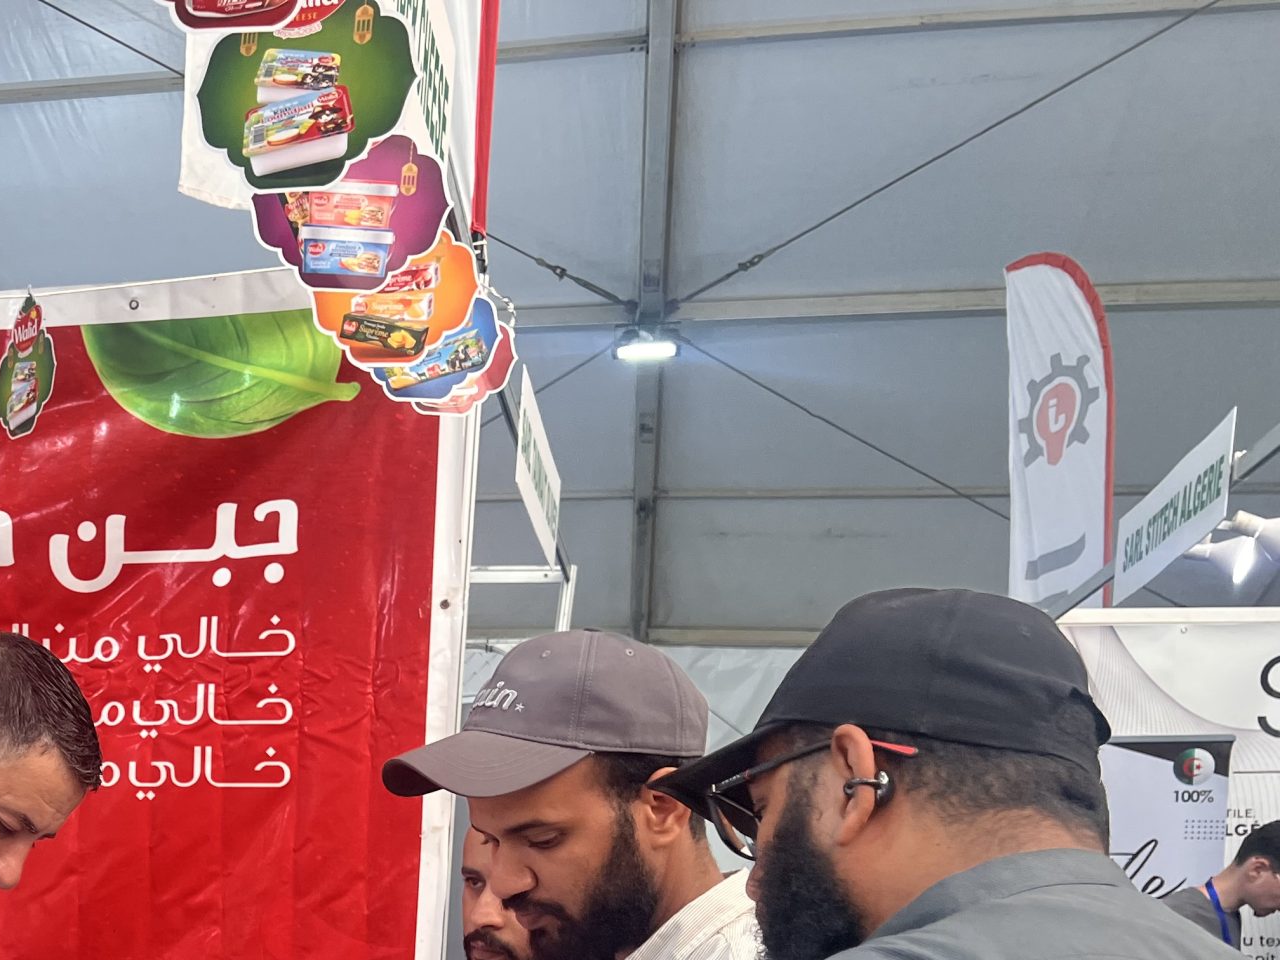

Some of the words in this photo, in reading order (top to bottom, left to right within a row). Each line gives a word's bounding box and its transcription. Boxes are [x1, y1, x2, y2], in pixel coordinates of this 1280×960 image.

[388, 274, 412, 285] prême
[13, 318, 39, 345] Walid
[1180, 455, 1226, 526] ALGERIE
[47, 498, 299, 594] جبن
[137, 614, 296, 673] خالي
[132, 683, 293, 739] خالي
[128, 745, 291, 800] خالي
[1173, 789, 1214, 804] 100%
